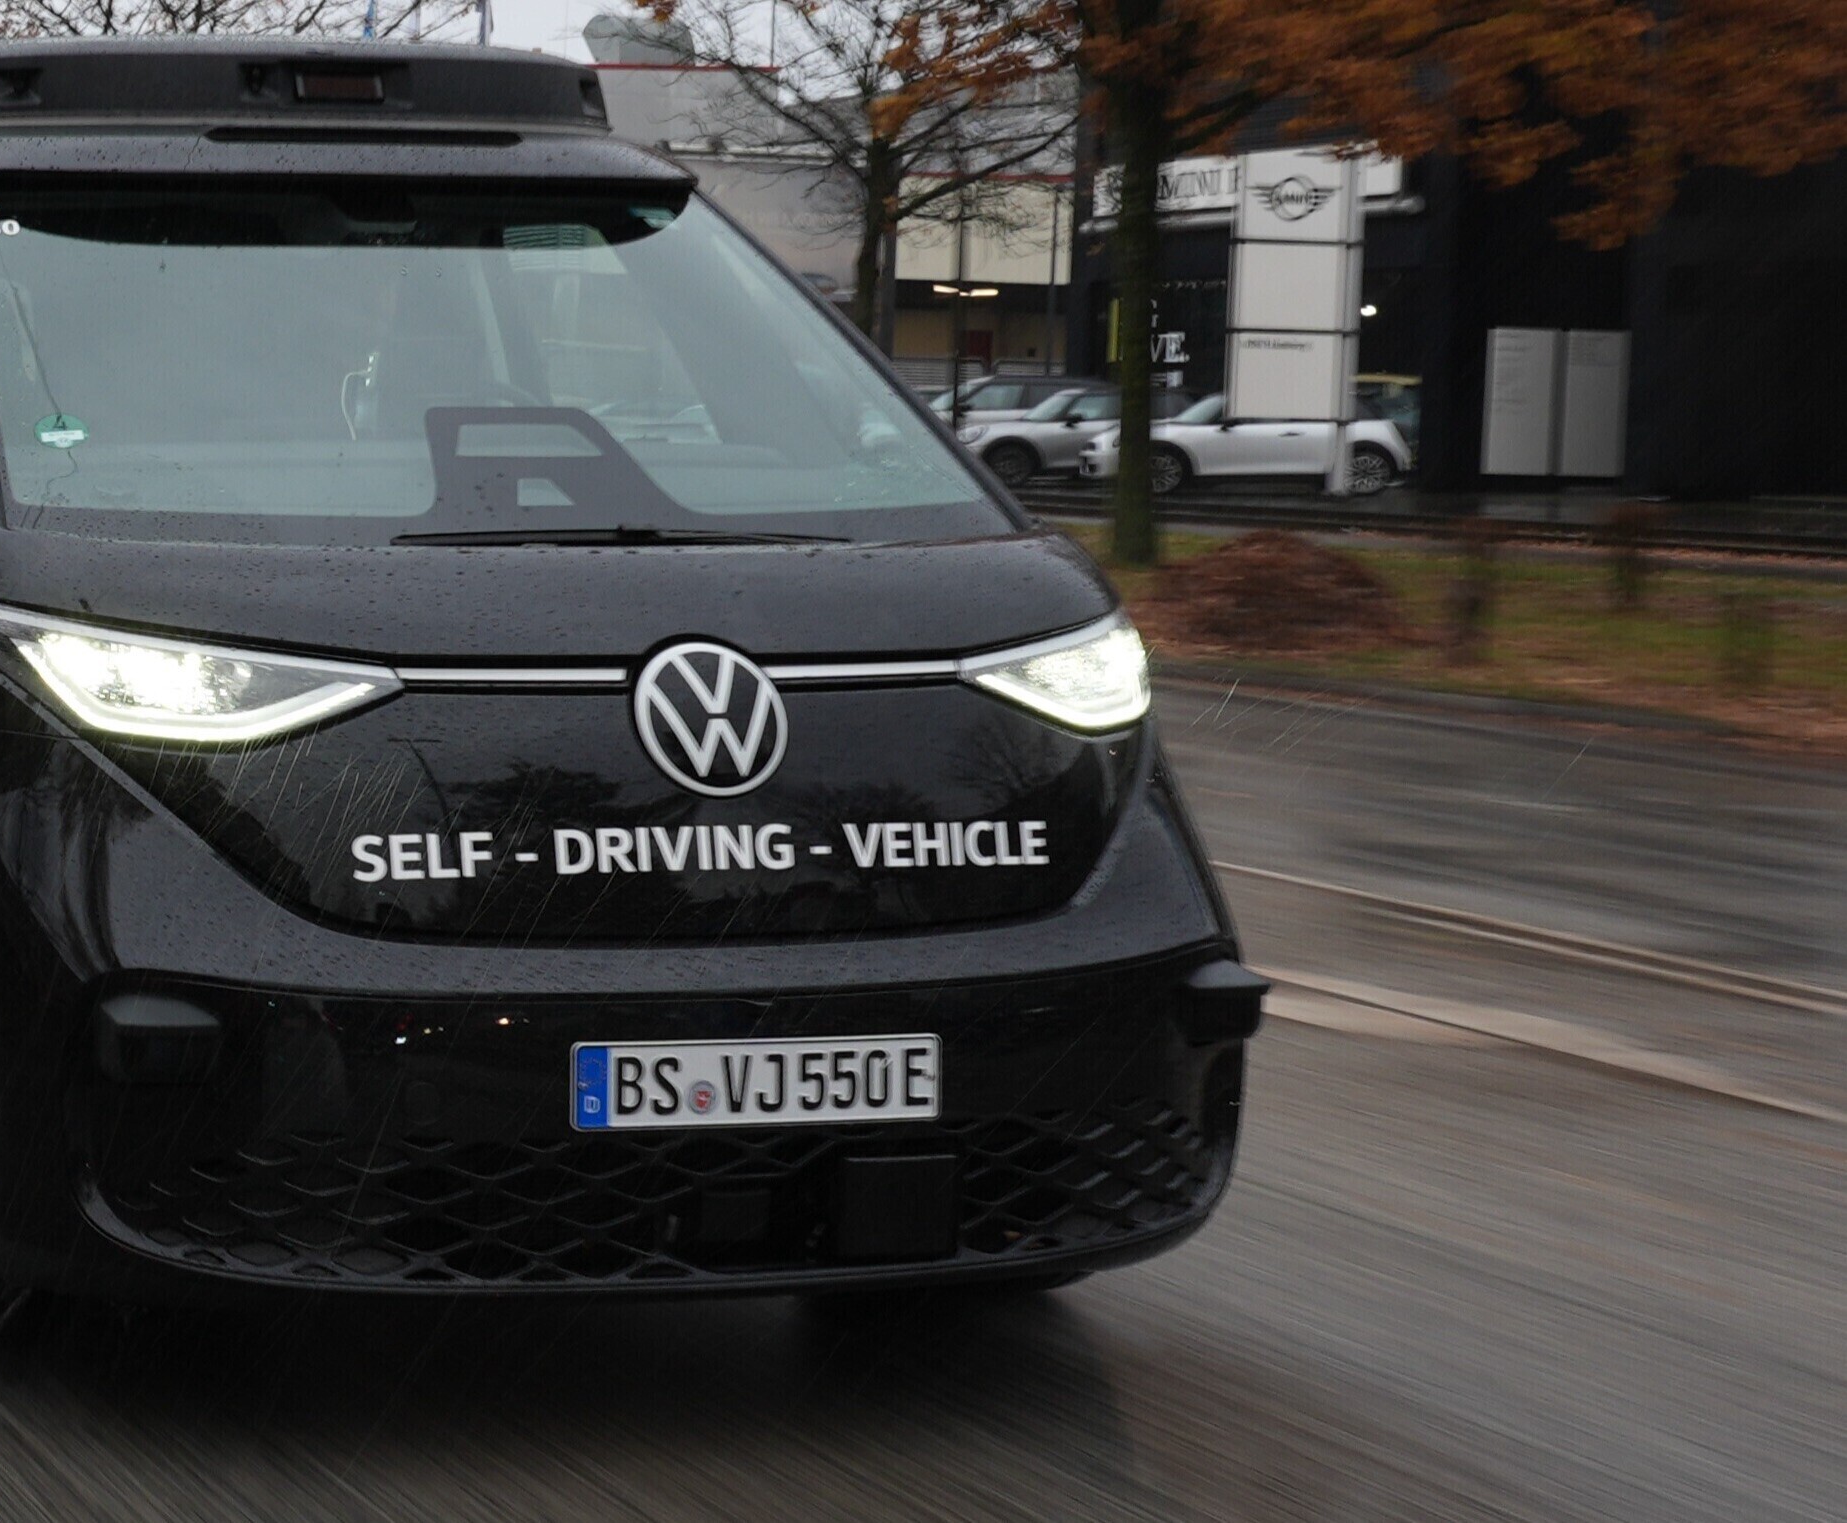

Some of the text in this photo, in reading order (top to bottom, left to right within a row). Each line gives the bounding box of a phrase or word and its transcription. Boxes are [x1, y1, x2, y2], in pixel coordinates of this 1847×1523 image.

[351, 832, 494, 882] SELF
[552, 823, 796, 875] DRIVING
[842, 820, 1049, 868] VEHICLE
[584, 1095, 600, 1113] D
[617, 1056, 682, 1115] BS
